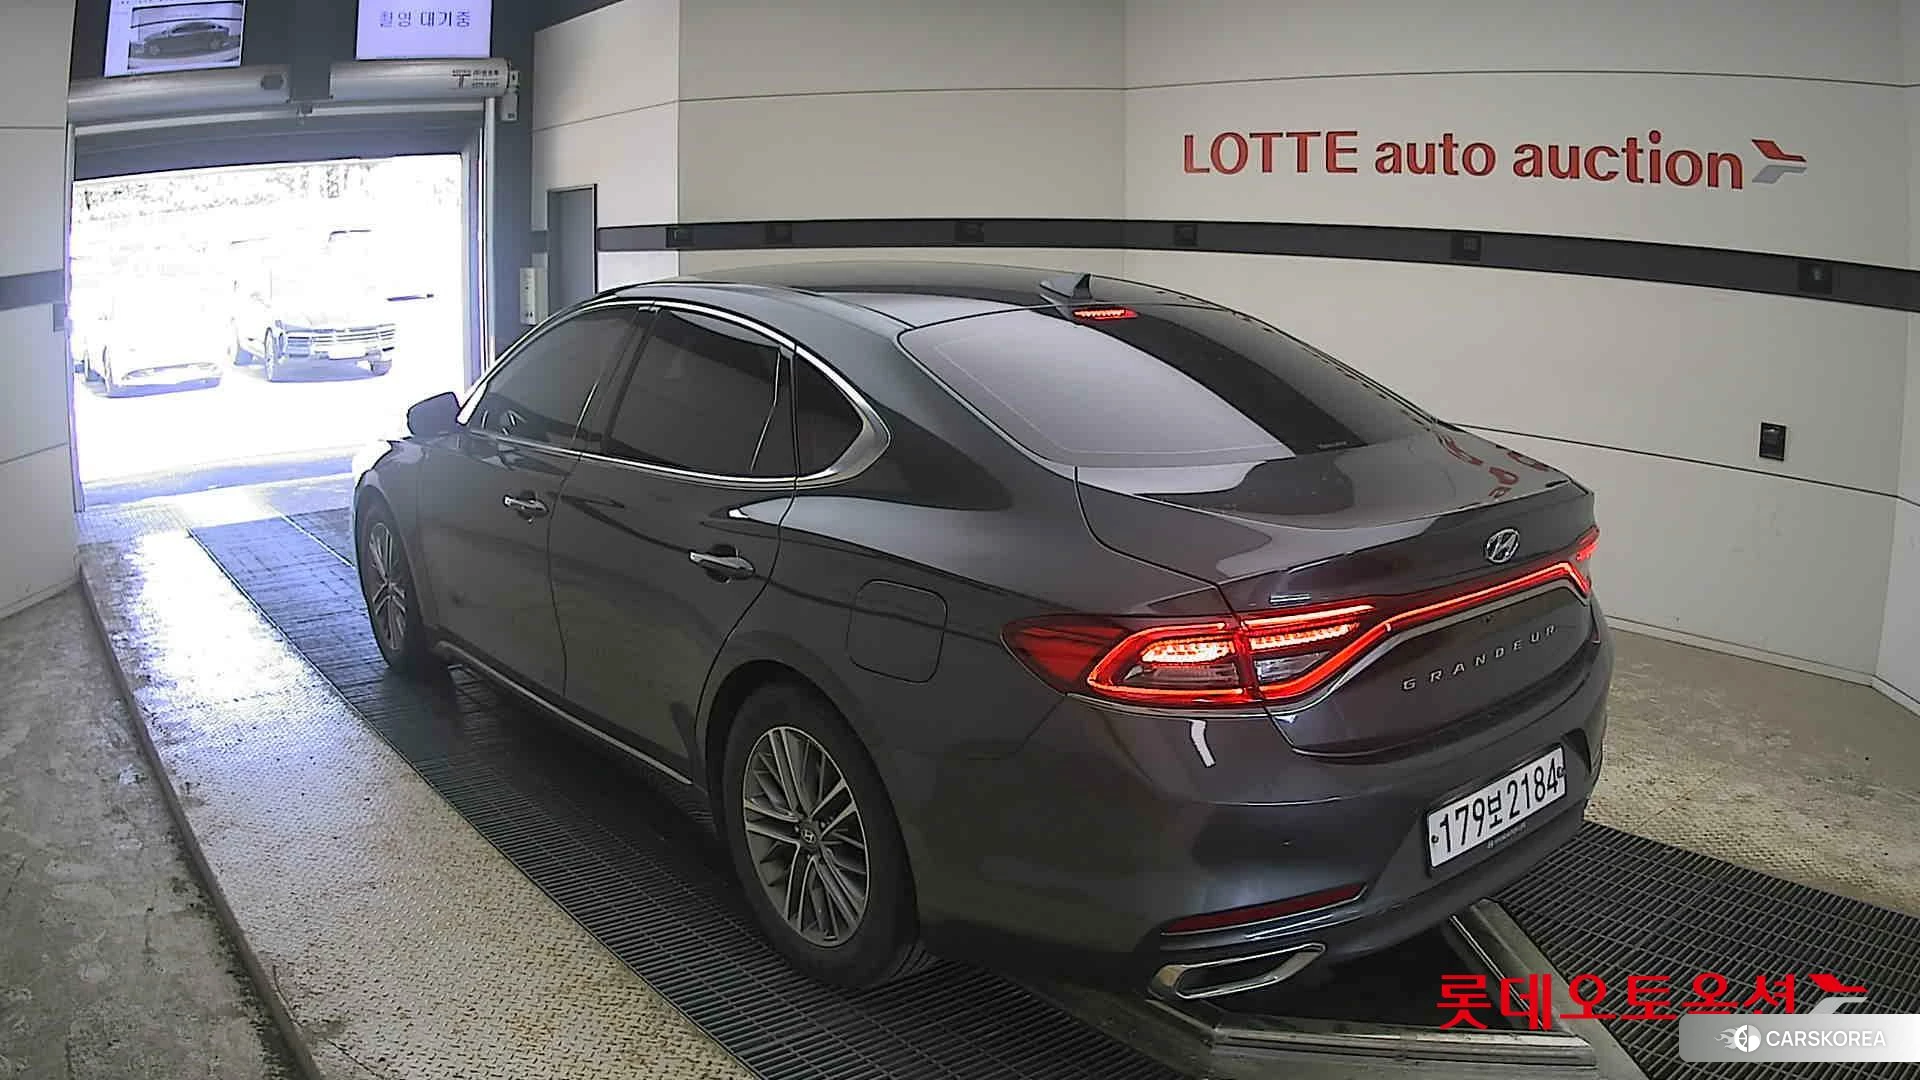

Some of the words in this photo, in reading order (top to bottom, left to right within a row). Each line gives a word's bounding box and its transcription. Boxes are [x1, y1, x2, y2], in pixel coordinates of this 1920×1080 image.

[420, 11, 470, 28] 대기중
[1184, 131, 1358, 175] LOTTE
[1374, 133, 1497, 177] auto
[1512, 130, 1743, 190] auction
[1402, 624, 1557, 691] GRANDEUR
[1439, 757, 1559, 853] 179보2184
